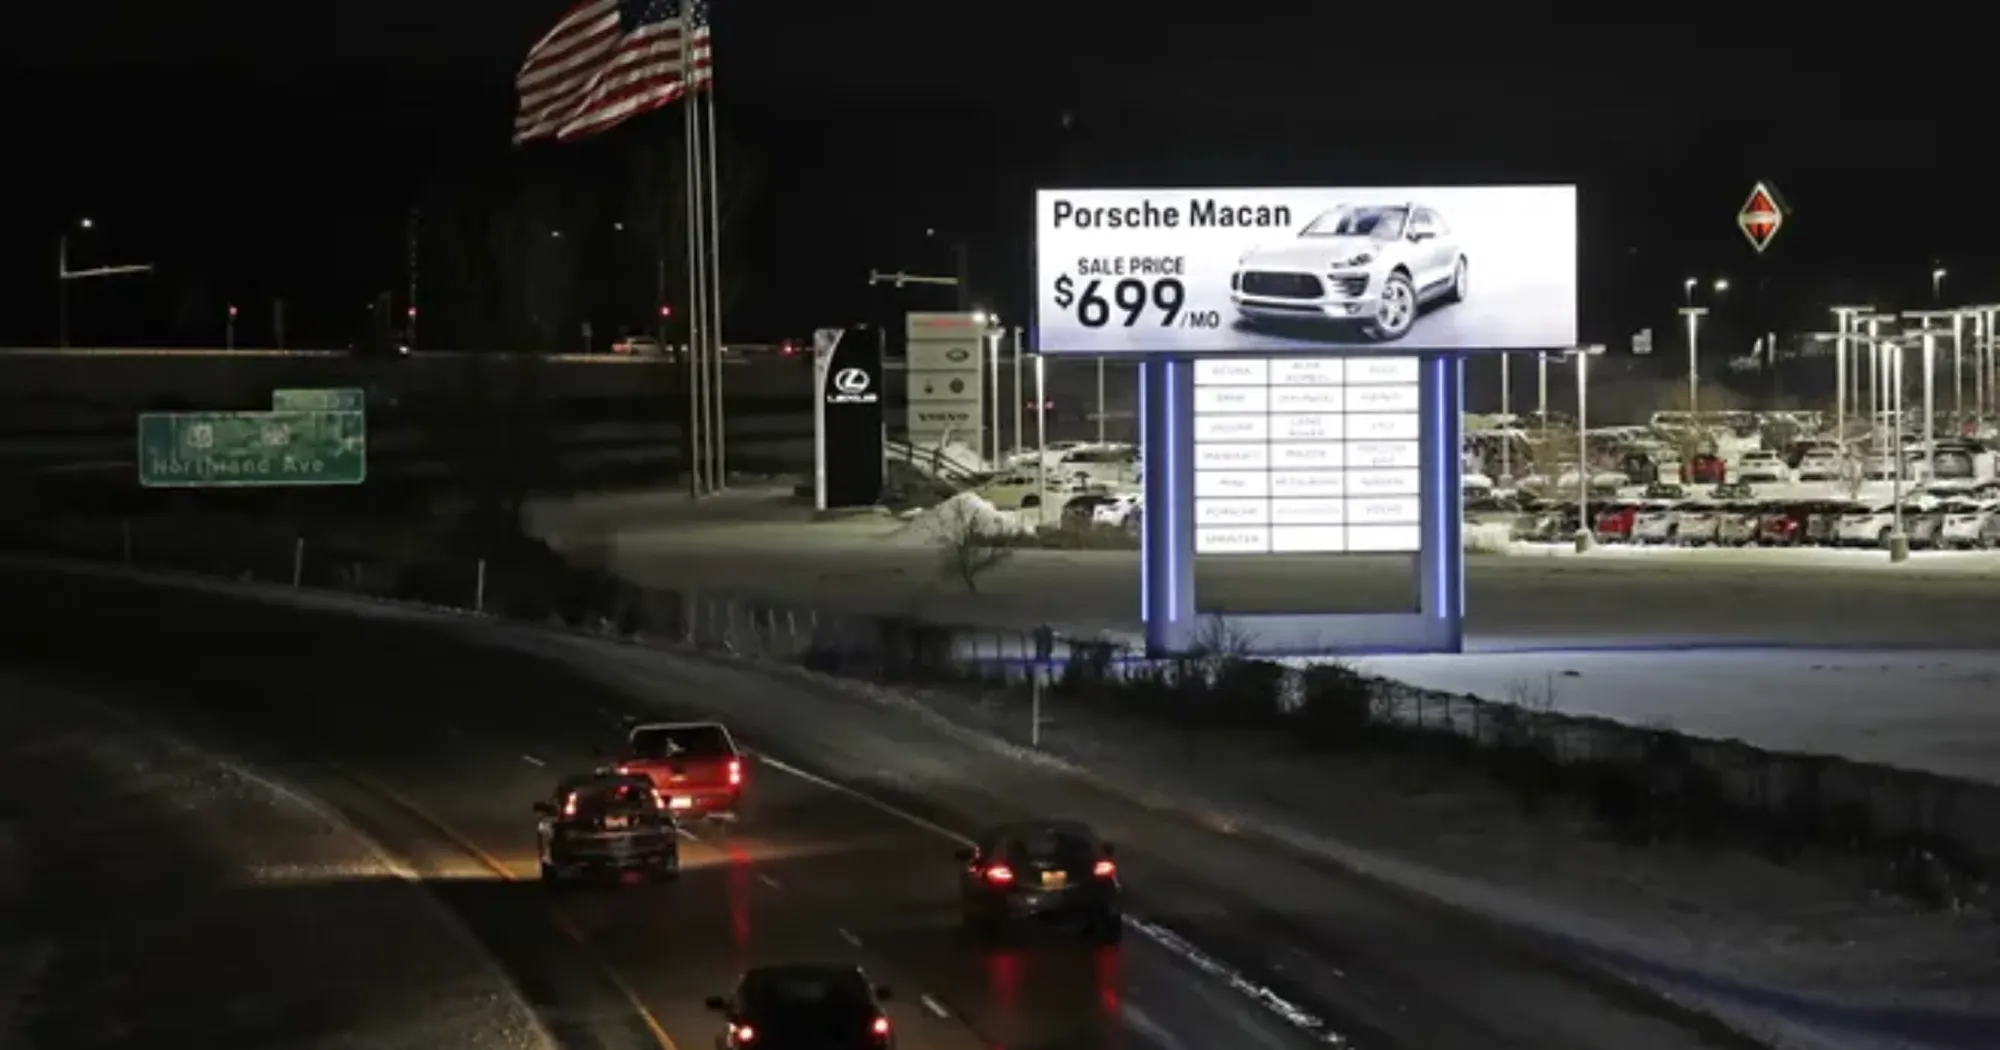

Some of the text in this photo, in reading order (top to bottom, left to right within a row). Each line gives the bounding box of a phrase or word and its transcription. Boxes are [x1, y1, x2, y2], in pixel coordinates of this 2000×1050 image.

[1053, 199, 1292, 229] Porsche Macan
[1077, 256, 1185, 275] SALE PRICE
[282, 456, 325, 473] Ave
